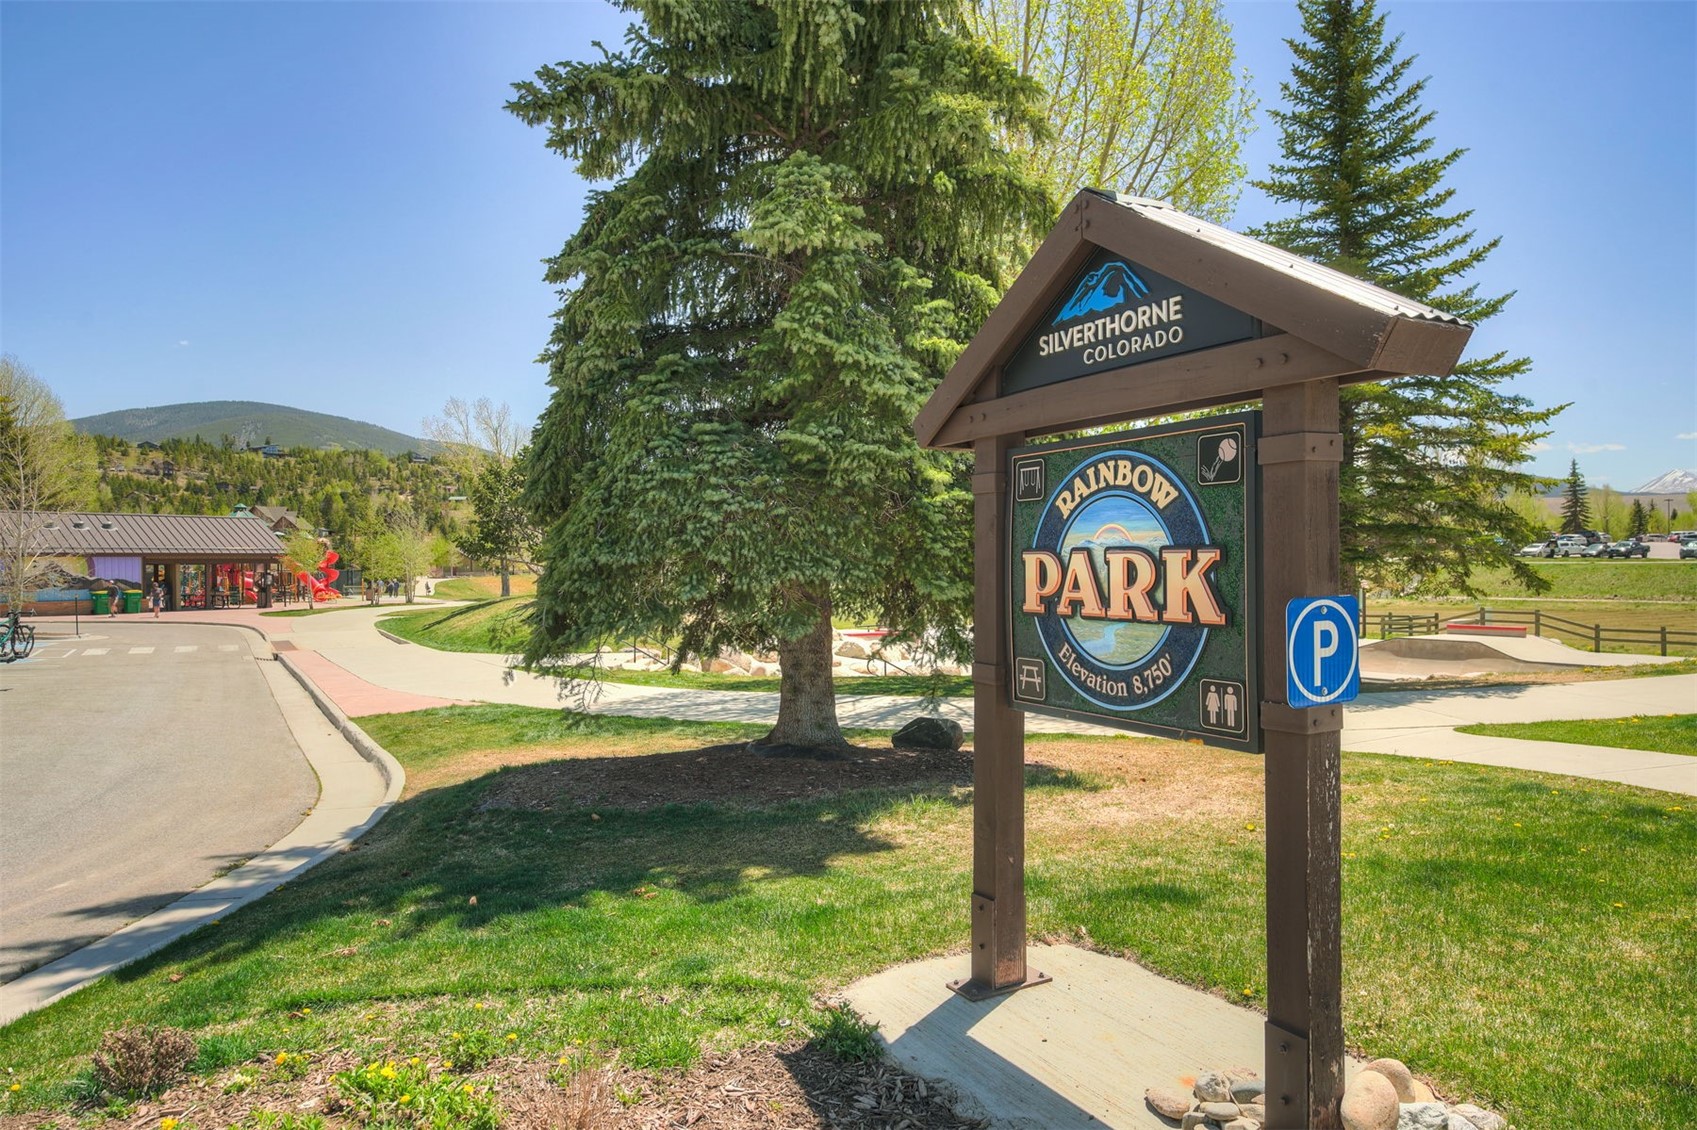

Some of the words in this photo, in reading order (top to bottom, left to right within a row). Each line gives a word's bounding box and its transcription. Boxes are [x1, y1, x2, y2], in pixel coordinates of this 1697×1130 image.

[1039, 295, 1183, 356] SILVERTHORNE
[1083, 326, 1183, 365] COLORADO
[1055, 460, 1179, 519] RAINBOW
[1022, 549, 1227, 625] PARK
[1058, 642, 1128, 697] Elevation
[1313, 620, 1339, 687] P
